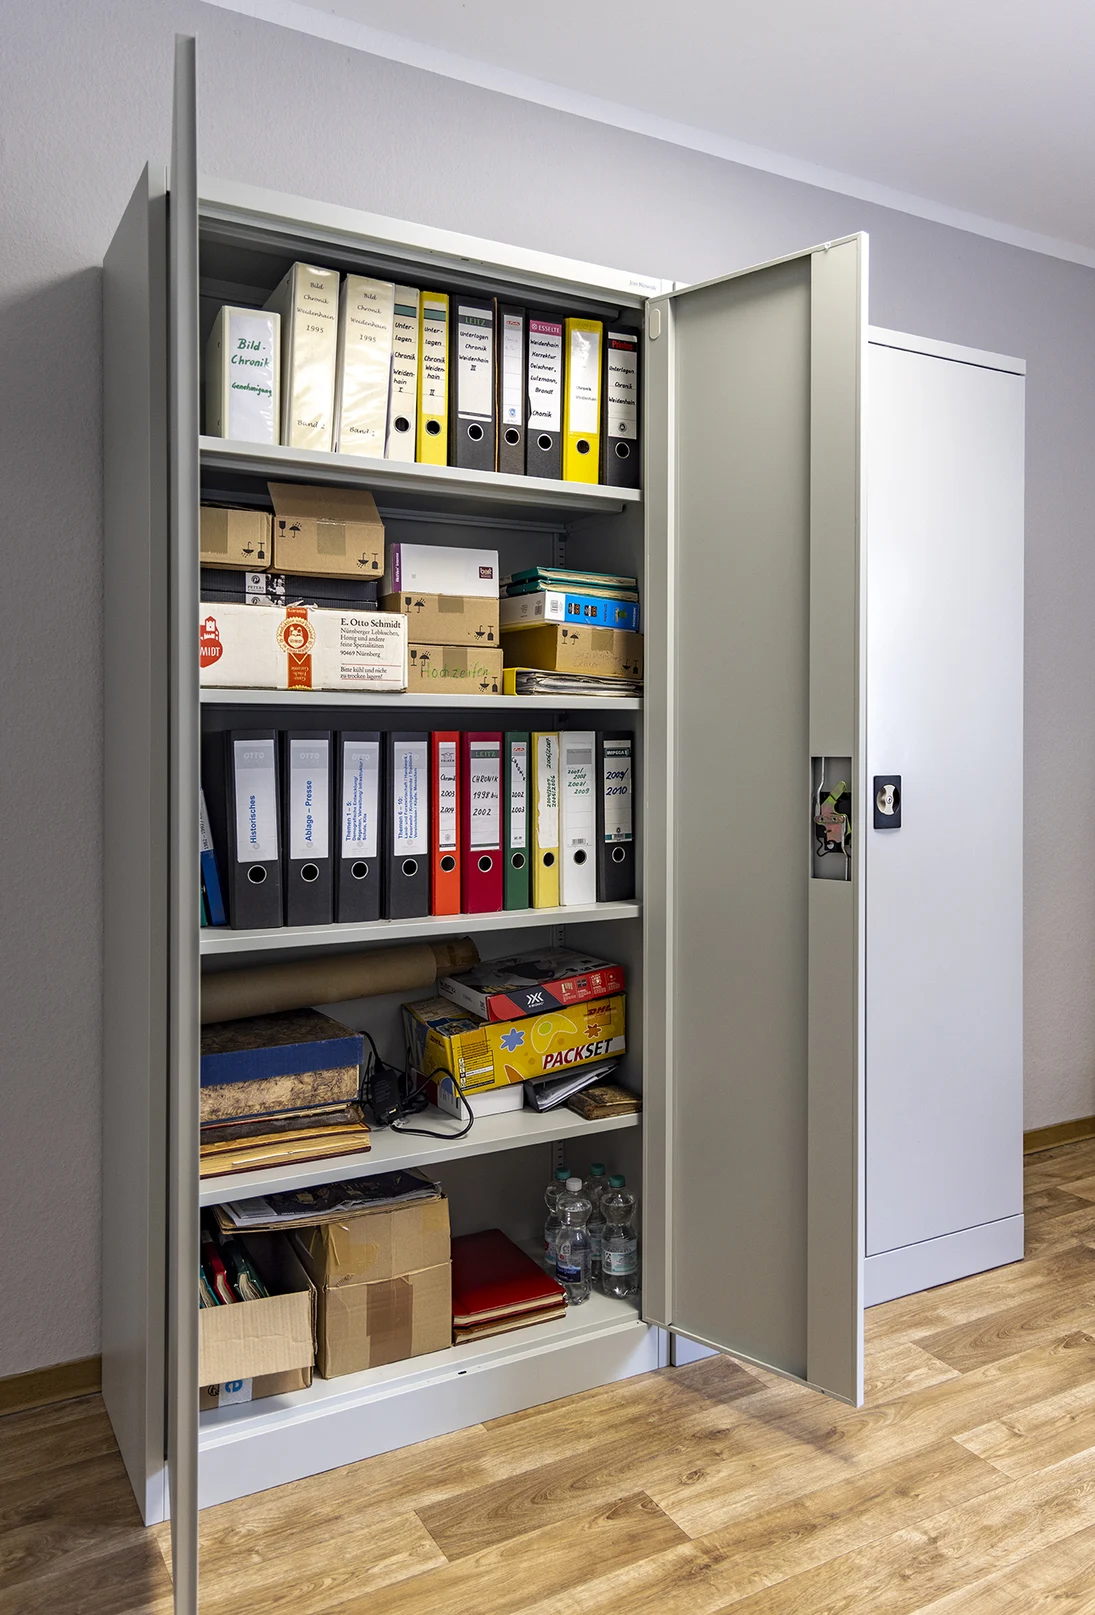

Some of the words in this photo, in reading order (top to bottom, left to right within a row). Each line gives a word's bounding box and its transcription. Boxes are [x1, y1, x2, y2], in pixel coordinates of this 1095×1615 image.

[310, 282, 324, 290] Bild
[303, 294, 329, 304] Chronik
[296, 307, 335, 320] Weidenhain
[356, 304, 382, 314] Chronik
[350, 317, 387, 330] Weidenhain
[465, 316, 486, 326] LEITZ
[306, 325, 324, 334] 1995
[538, 325, 560, 333] ESSELTE
[360, 334, 376, 343] 1995
[460, 331, 489, 341] Unterlagen
[465, 343, 487, 351] Chronik
[530, 339, 559, 348] Weidenhain
[394, 351, 416, 360] Chronik
[424, 355, 446, 364] Chronik
[459, 354, 489, 364] Weidenhain
[532, 351, 556, 360] Korrektur
[231, 354, 270, 367] Chronik
[609, 366, 635, 374] Unterlagen
[608, 397, 635, 406] Weidenhain
[340, 618, 349, 626] E.
[350, 618, 369, 627] Otto
[370, 619, 401, 628] Schmidt
[472, 775, 498, 783] CHRONIK
[473, 791, 490, 799] 1998
[606, 786, 628, 795] 2010
[305, 815, 313, 841] Ablage
[588, 1005, 611, 1016] DHL
[543, 1038, 613, 1069] PACKSET
